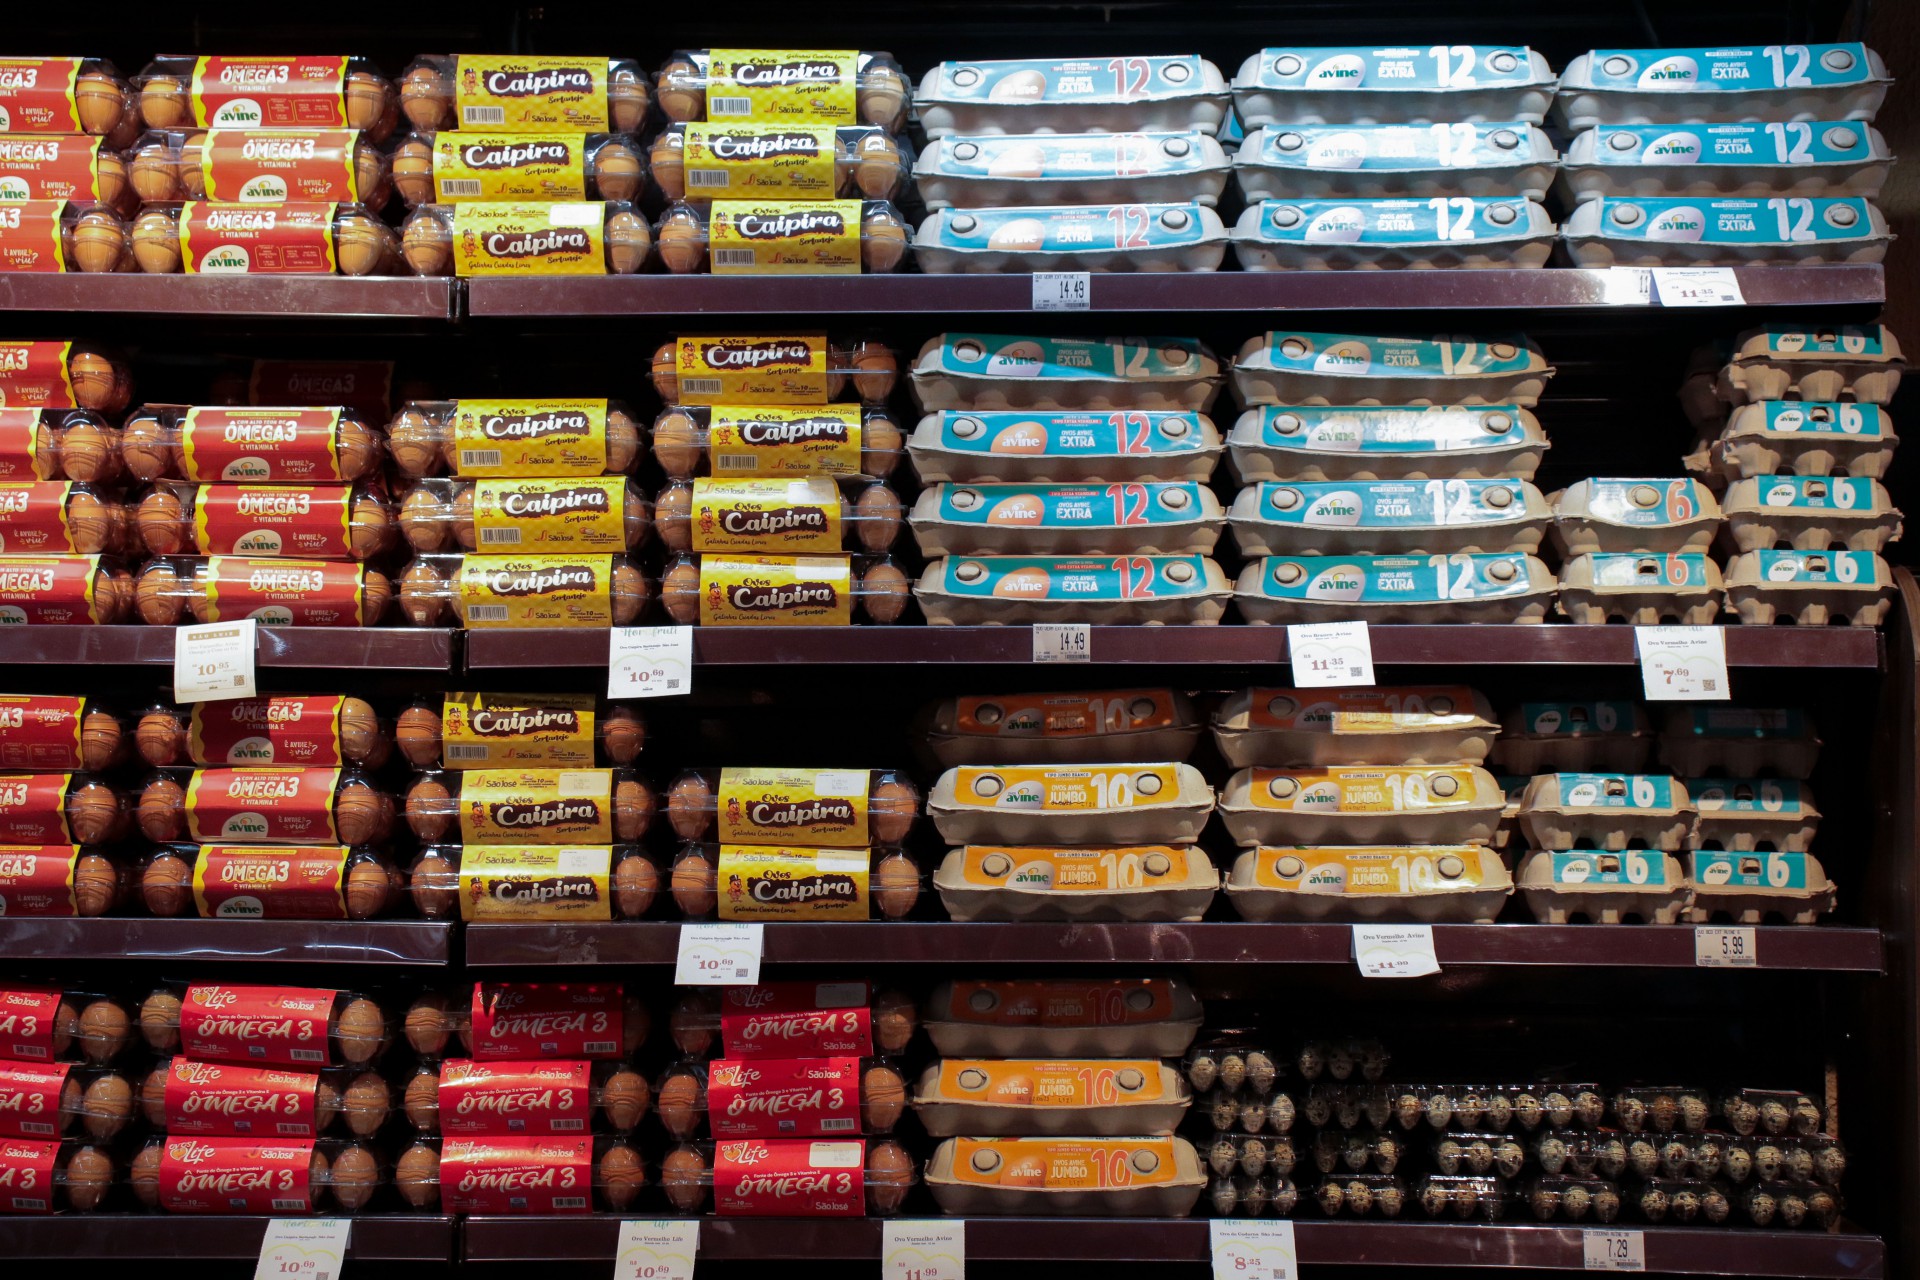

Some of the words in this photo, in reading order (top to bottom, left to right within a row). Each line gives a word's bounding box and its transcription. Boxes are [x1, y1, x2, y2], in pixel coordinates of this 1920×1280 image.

[736, 63, 837, 85] Caipira
[1319, 68, 1358, 78] avine
[1378, 67, 1416, 78] EXTRA
[1429, 46, 1476, 87] 12
[1650, 68, 1691, 80] avine
[1711, 67, 1750, 80] EXTRA
[1763, 45, 1811, 88] 12
[488, 69, 589, 94] Caipira
[1108, 58, 1150, 101] 12
[220, 110, 259, 122] avine
[714, 136, 815, 158] Caipira
[1714, 142, 1753, 155] EXTRA
[1766, 122, 1814, 164] 12
[465, 143, 565, 168] Caipira
[246, 185, 284, 197] avine
[739, 214, 840, 237] Caipira
[1429, 196, 1475, 240] 12
[1658, 219, 1698, 231] avine
[1718, 219, 1755, 232] EXTRA
[1767, 198, 1816, 241] 12
[488, 231, 586, 256] Caipira
[707, 344, 806, 366] Caipira
[999, 355, 1037, 366] avine
[1384, 355, 1420, 366] EXTRA
[1431, 334, 1477, 375] 12
[486, 415, 585, 437] Caipira
[1839, 403, 1862, 434] 6
[743, 420, 843, 443] Caipira
[1002, 436, 1040, 447] avine
[1060, 435, 1095, 447] EXTRA
[1109, 411, 1151, 454] 12
[229, 466, 267, 478] avine
[505, 491, 604, 514] Caipira
[1425, 479, 1470, 525] 12
[1666, 481, 1690, 522] 6
[1832, 476, 1856, 509] 6
[1057, 507, 1092, 519] EXTRA
[1105, 484, 1149, 525] 12
[1316, 505, 1355, 516] avine
[1375, 505, 1411, 516] EXTRA
[724, 511, 823, 534] Caipira
[241, 539, 279, 551] avine
[1112, 556, 1155, 598] 12
[1428, 554, 1475, 599] 12
[1834, 551, 1858, 583] 6
[492, 569, 591, 592] Caipira
[1004, 581, 1042, 591] avine
[1062, 580, 1098, 592] EXTRA
[1318, 579, 1358, 590] avine
[1378, 578, 1415, 590] EXTRA
[733, 586, 832, 609] Caipira
[473, 709, 573, 733] Caipira
[1006, 792, 1039, 802] avine
[1048, 791, 1086, 803] JUMBO
[1090, 773, 1133, 809] 10
[1303, 793, 1336, 803] avine
[1345, 792, 1382, 804] JUMBO
[1385, 773, 1428, 810] 10
[1632, 775, 1655, 808] 6
[497, 803, 594, 826] Caipira
[752, 802, 850, 825] Caipira
[229, 821, 266, 832] avine
[1016, 872, 1049, 883] avine
[1059, 872, 1096, 883] JUMBO
[1100, 853, 1143, 889] 10
[1309, 874, 1342, 884] avine
[1351, 873, 1388, 885] JUMBO
[1391, 855, 1435, 892] 10
[1626, 852, 1649, 885] 6
[1767, 853, 1790, 888] 6
[754, 879, 852, 901] Caipira
[205, 987, 237, 1012] Life
[297, 1020, 313, 1040] 3
[843, 1012, 858, 1033] 3
[190, 1062, 222, 1084] Life
[731, 1065, 762, 1087] Life
[997, 1084, 1029, 1095] avine
[1038, 1085, 1074, 1096] JUMBO
[1077, 1067, 1119, 1105] 10
[285, 1094, 300, 1113] 3
[558, 1089, 573, 1110] 3
[828, 1088, 844, 1110] 3
[184, 1142, 216, 1164] Life
[739, 1142, 769, 1165] Life
[561, 1167, 576, 1188] 3
[1010, 1166, 1041, 1177] avine
[1050, 1166, 1087, 1178] JUMBO
[1091, 1148, 1132, 1187] 10
[279, 1169, 294, 1191] 3
[836, 1173, 851, 1194] 3
